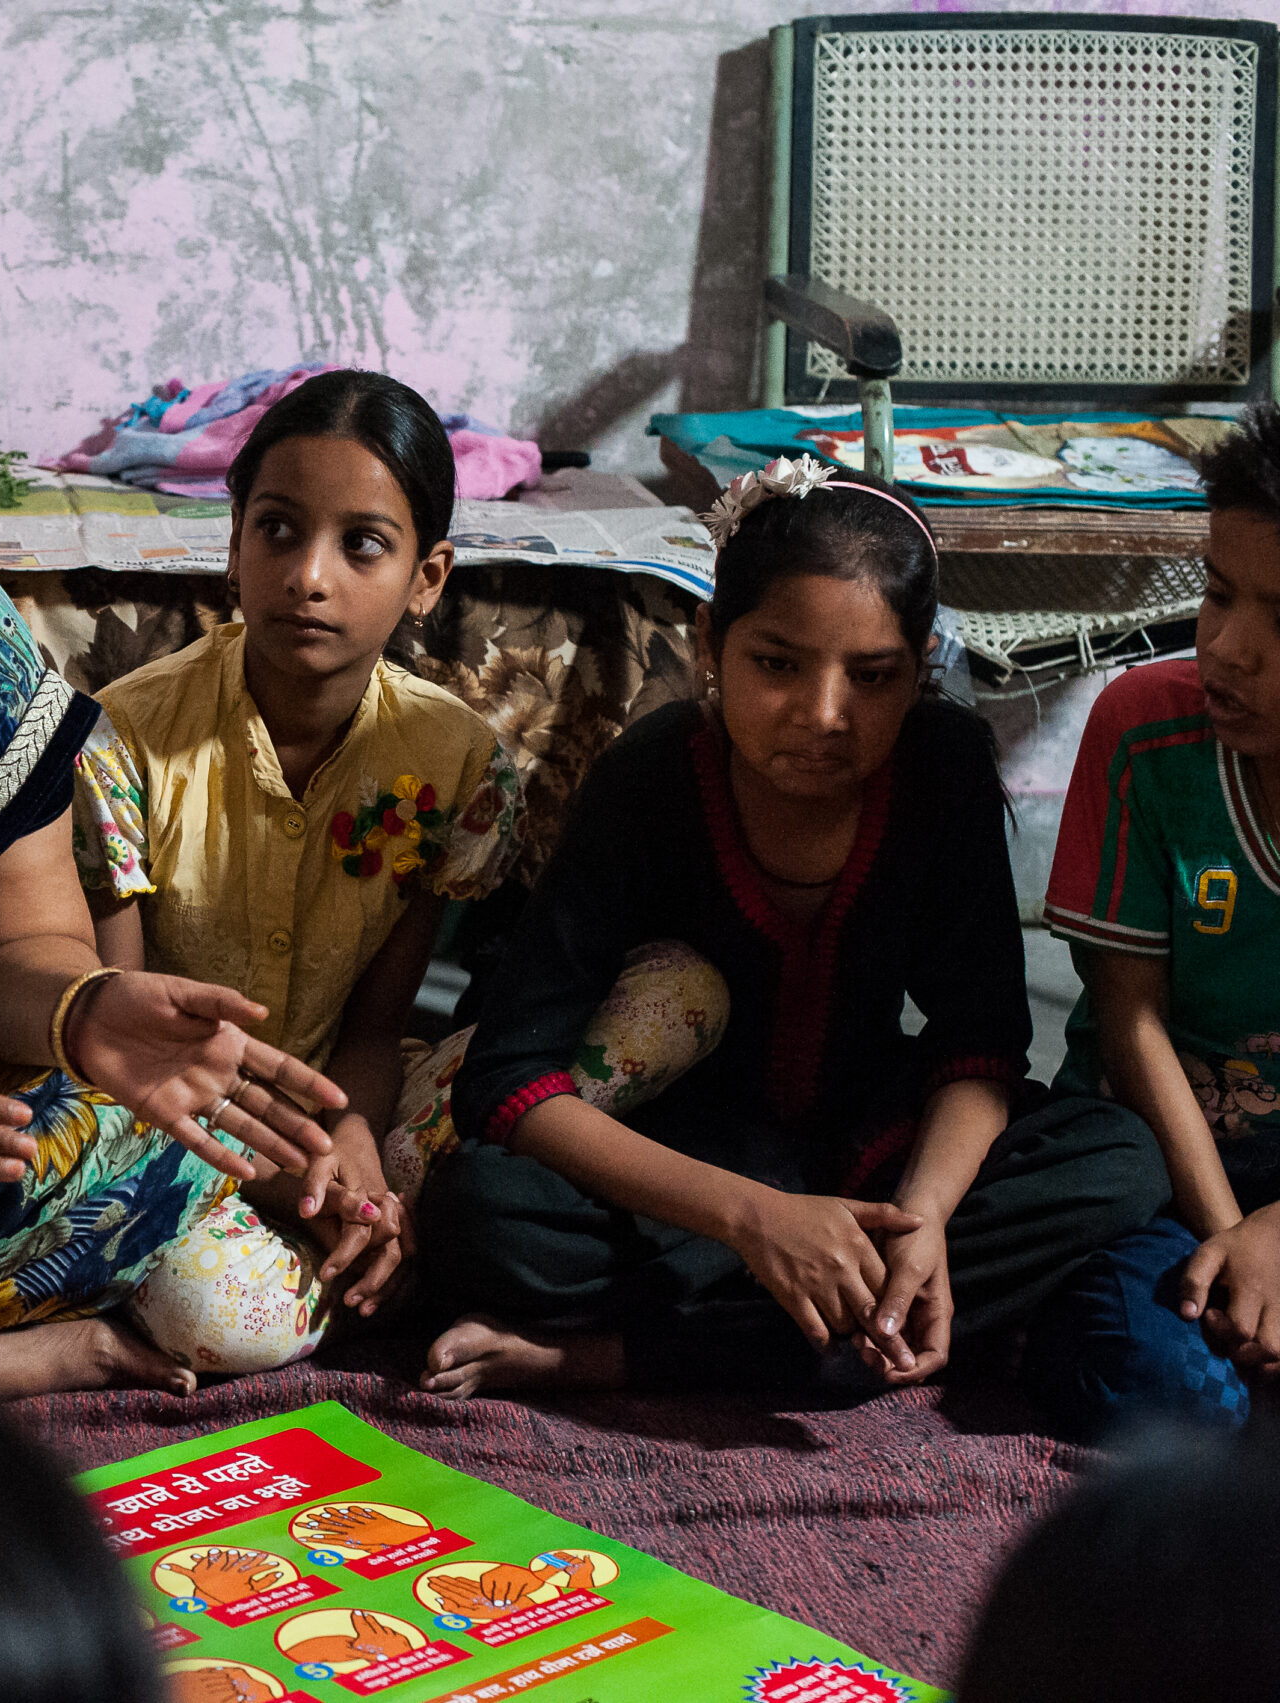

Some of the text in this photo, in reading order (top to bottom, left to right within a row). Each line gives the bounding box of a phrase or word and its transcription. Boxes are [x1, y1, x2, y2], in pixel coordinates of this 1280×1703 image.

[1192, 866, 1238, 935] 9
[106, 1452, 274, 1514] खाने से पहले
[150, 1506, 223, 1532] धोना
[215, 1494, 259, 1510] ना
[253, 1474, 311, 1500] भूलें
[314, 1550, 339, 1565] 3
[176, 1598, 204, 1613] 2
[441, 1615, 467, 1629] 6
[301, 1664, 329, 1679] 5
